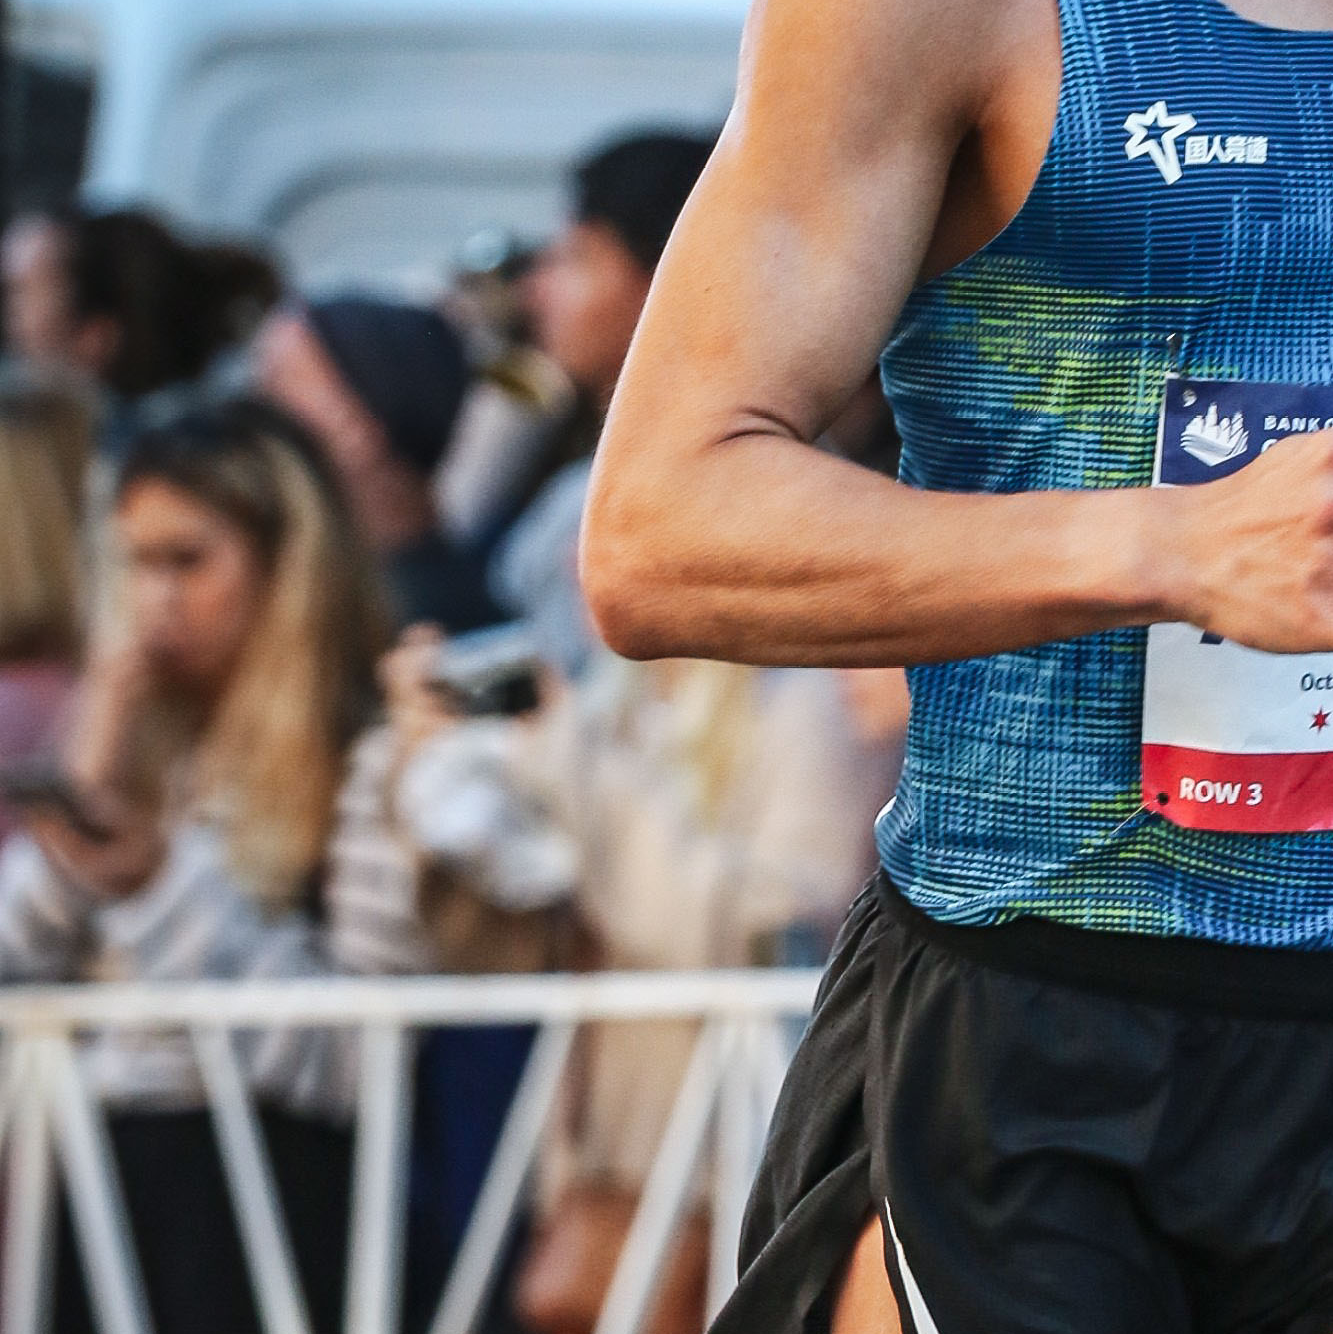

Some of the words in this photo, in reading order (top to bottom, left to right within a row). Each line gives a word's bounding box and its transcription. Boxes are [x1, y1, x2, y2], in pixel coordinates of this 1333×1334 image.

[1264, 415, 1320, 432] BANK
[1179, 777, 1242, 805] ROW
[1246, 783, 1263, 805] 3
